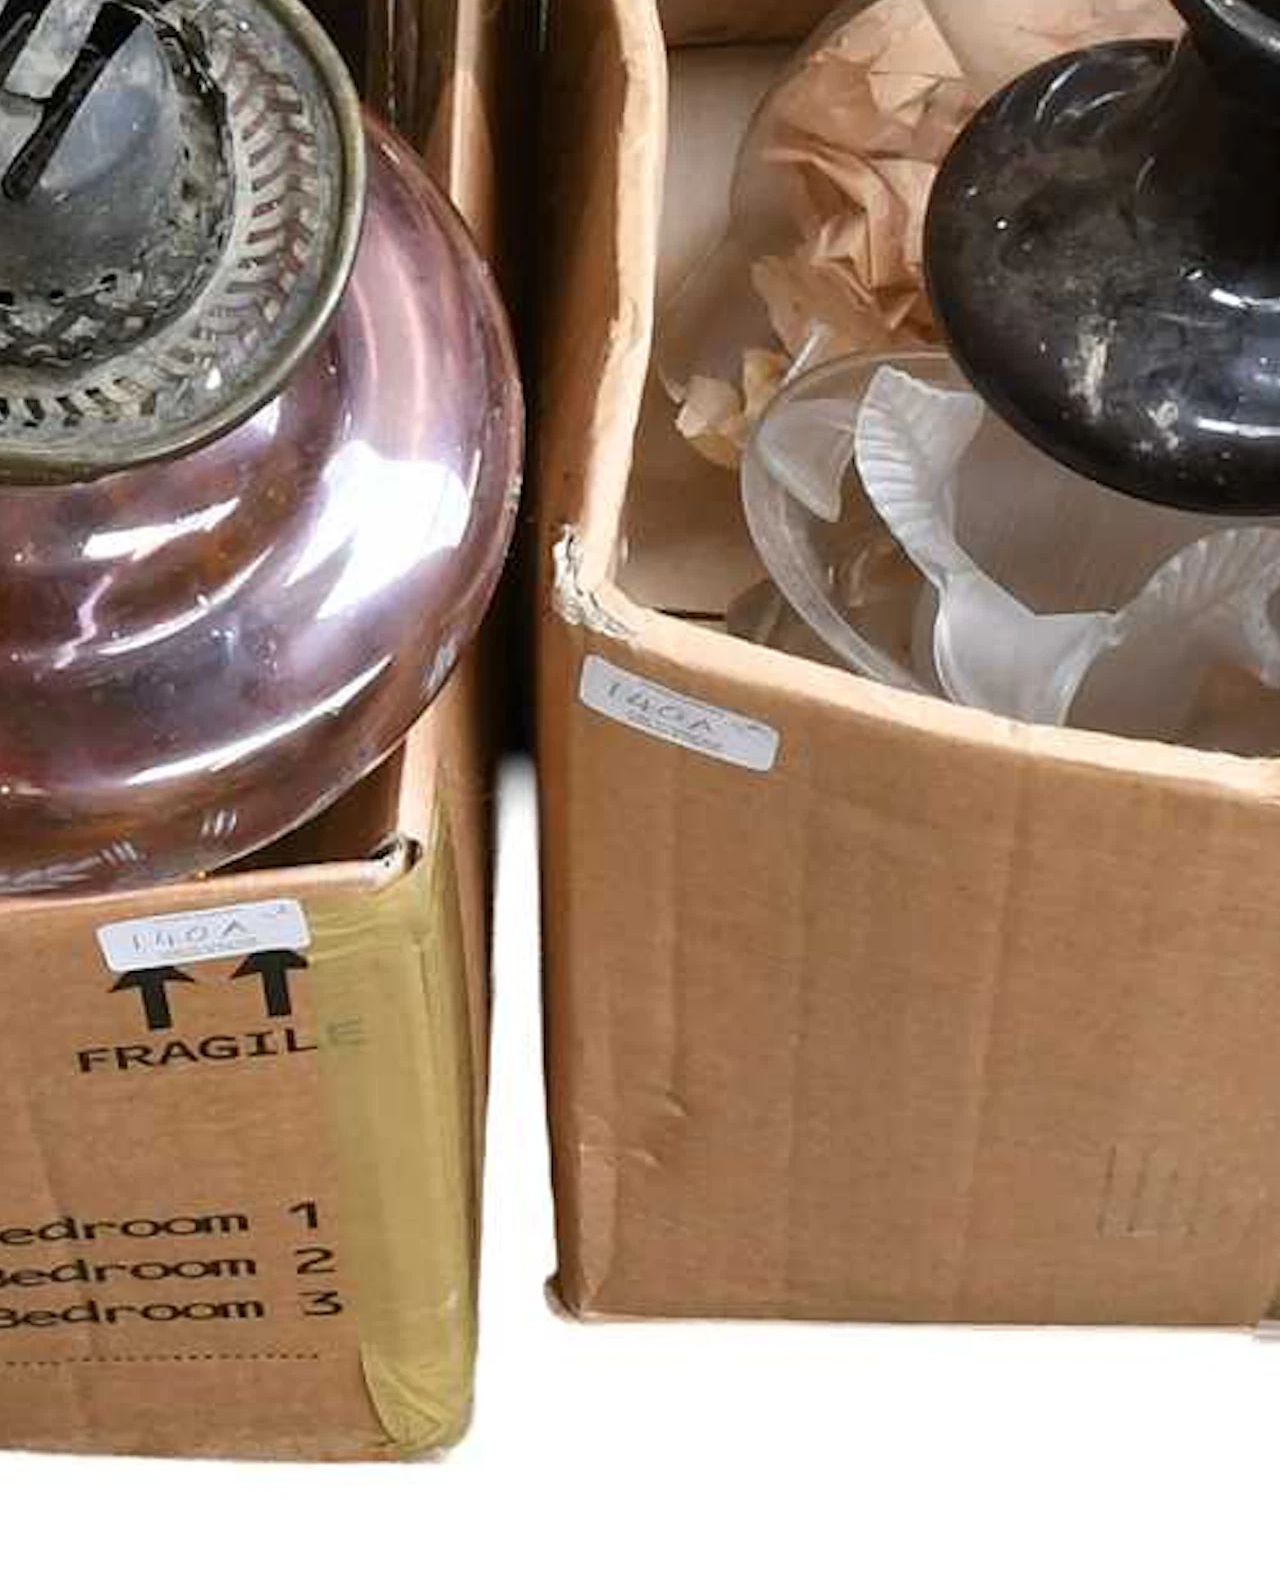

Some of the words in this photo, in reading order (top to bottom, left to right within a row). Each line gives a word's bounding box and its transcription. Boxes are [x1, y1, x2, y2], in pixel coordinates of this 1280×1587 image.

[287, 1200, 319, 1230] 1
[293, 1246, 336, 1276] 2
[298, 1289, 344, 1318] 3
